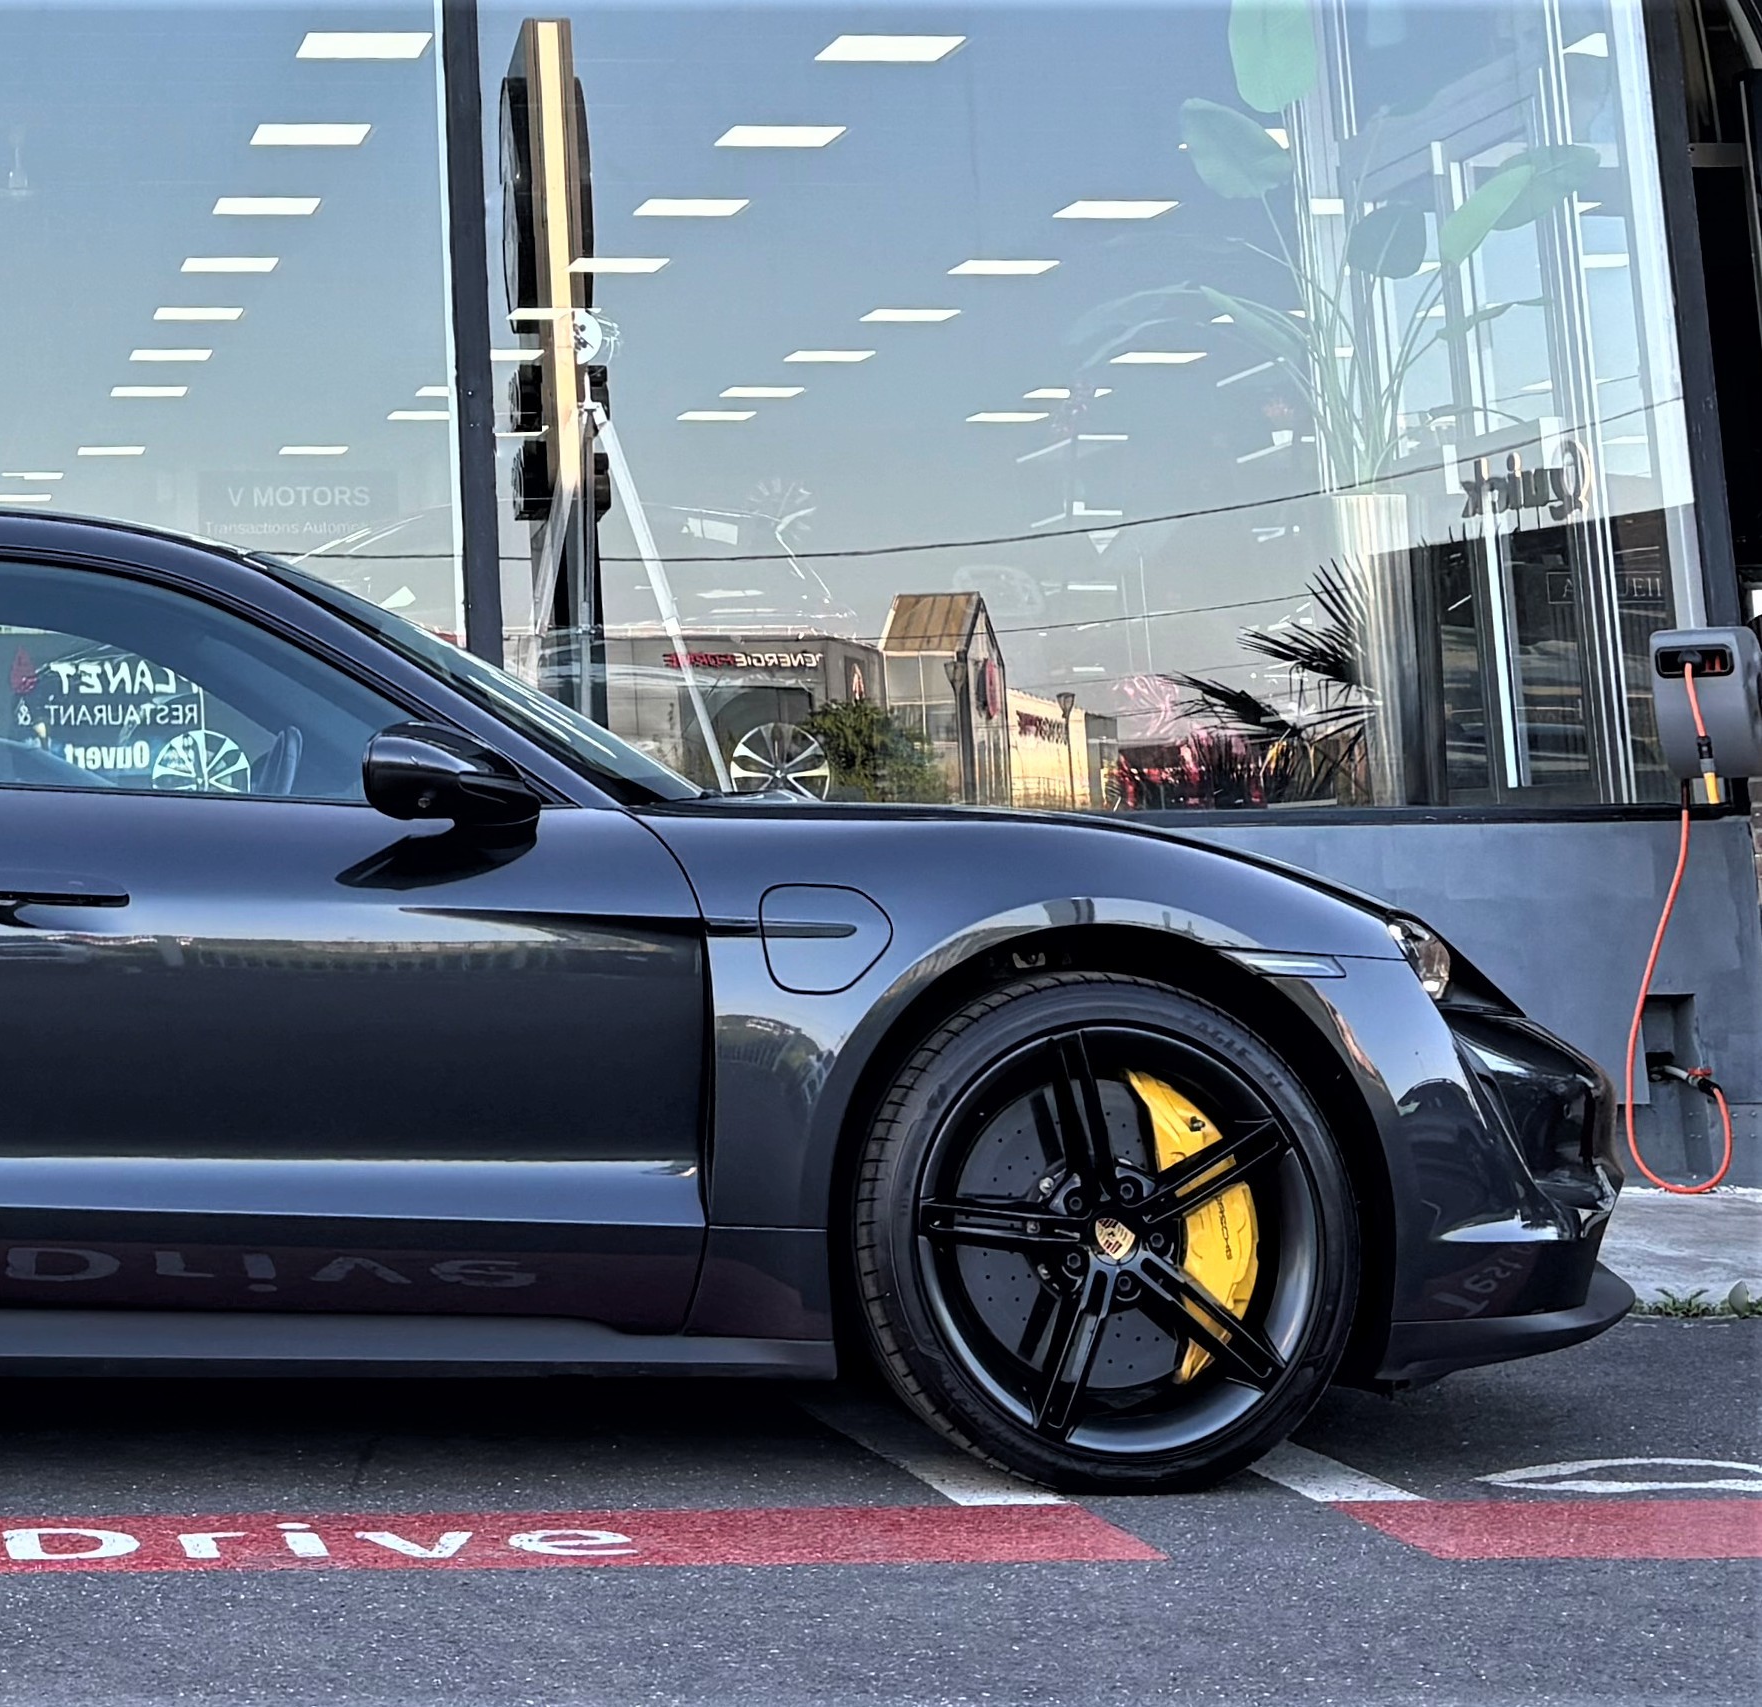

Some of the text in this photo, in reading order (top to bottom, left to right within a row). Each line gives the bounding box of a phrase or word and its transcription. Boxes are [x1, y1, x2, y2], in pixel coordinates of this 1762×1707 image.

[228, 486, 372, 508] V MOTORS
[205, 520, 300, 535] Transactions
[2, 1523, 640, 1560] Drive
